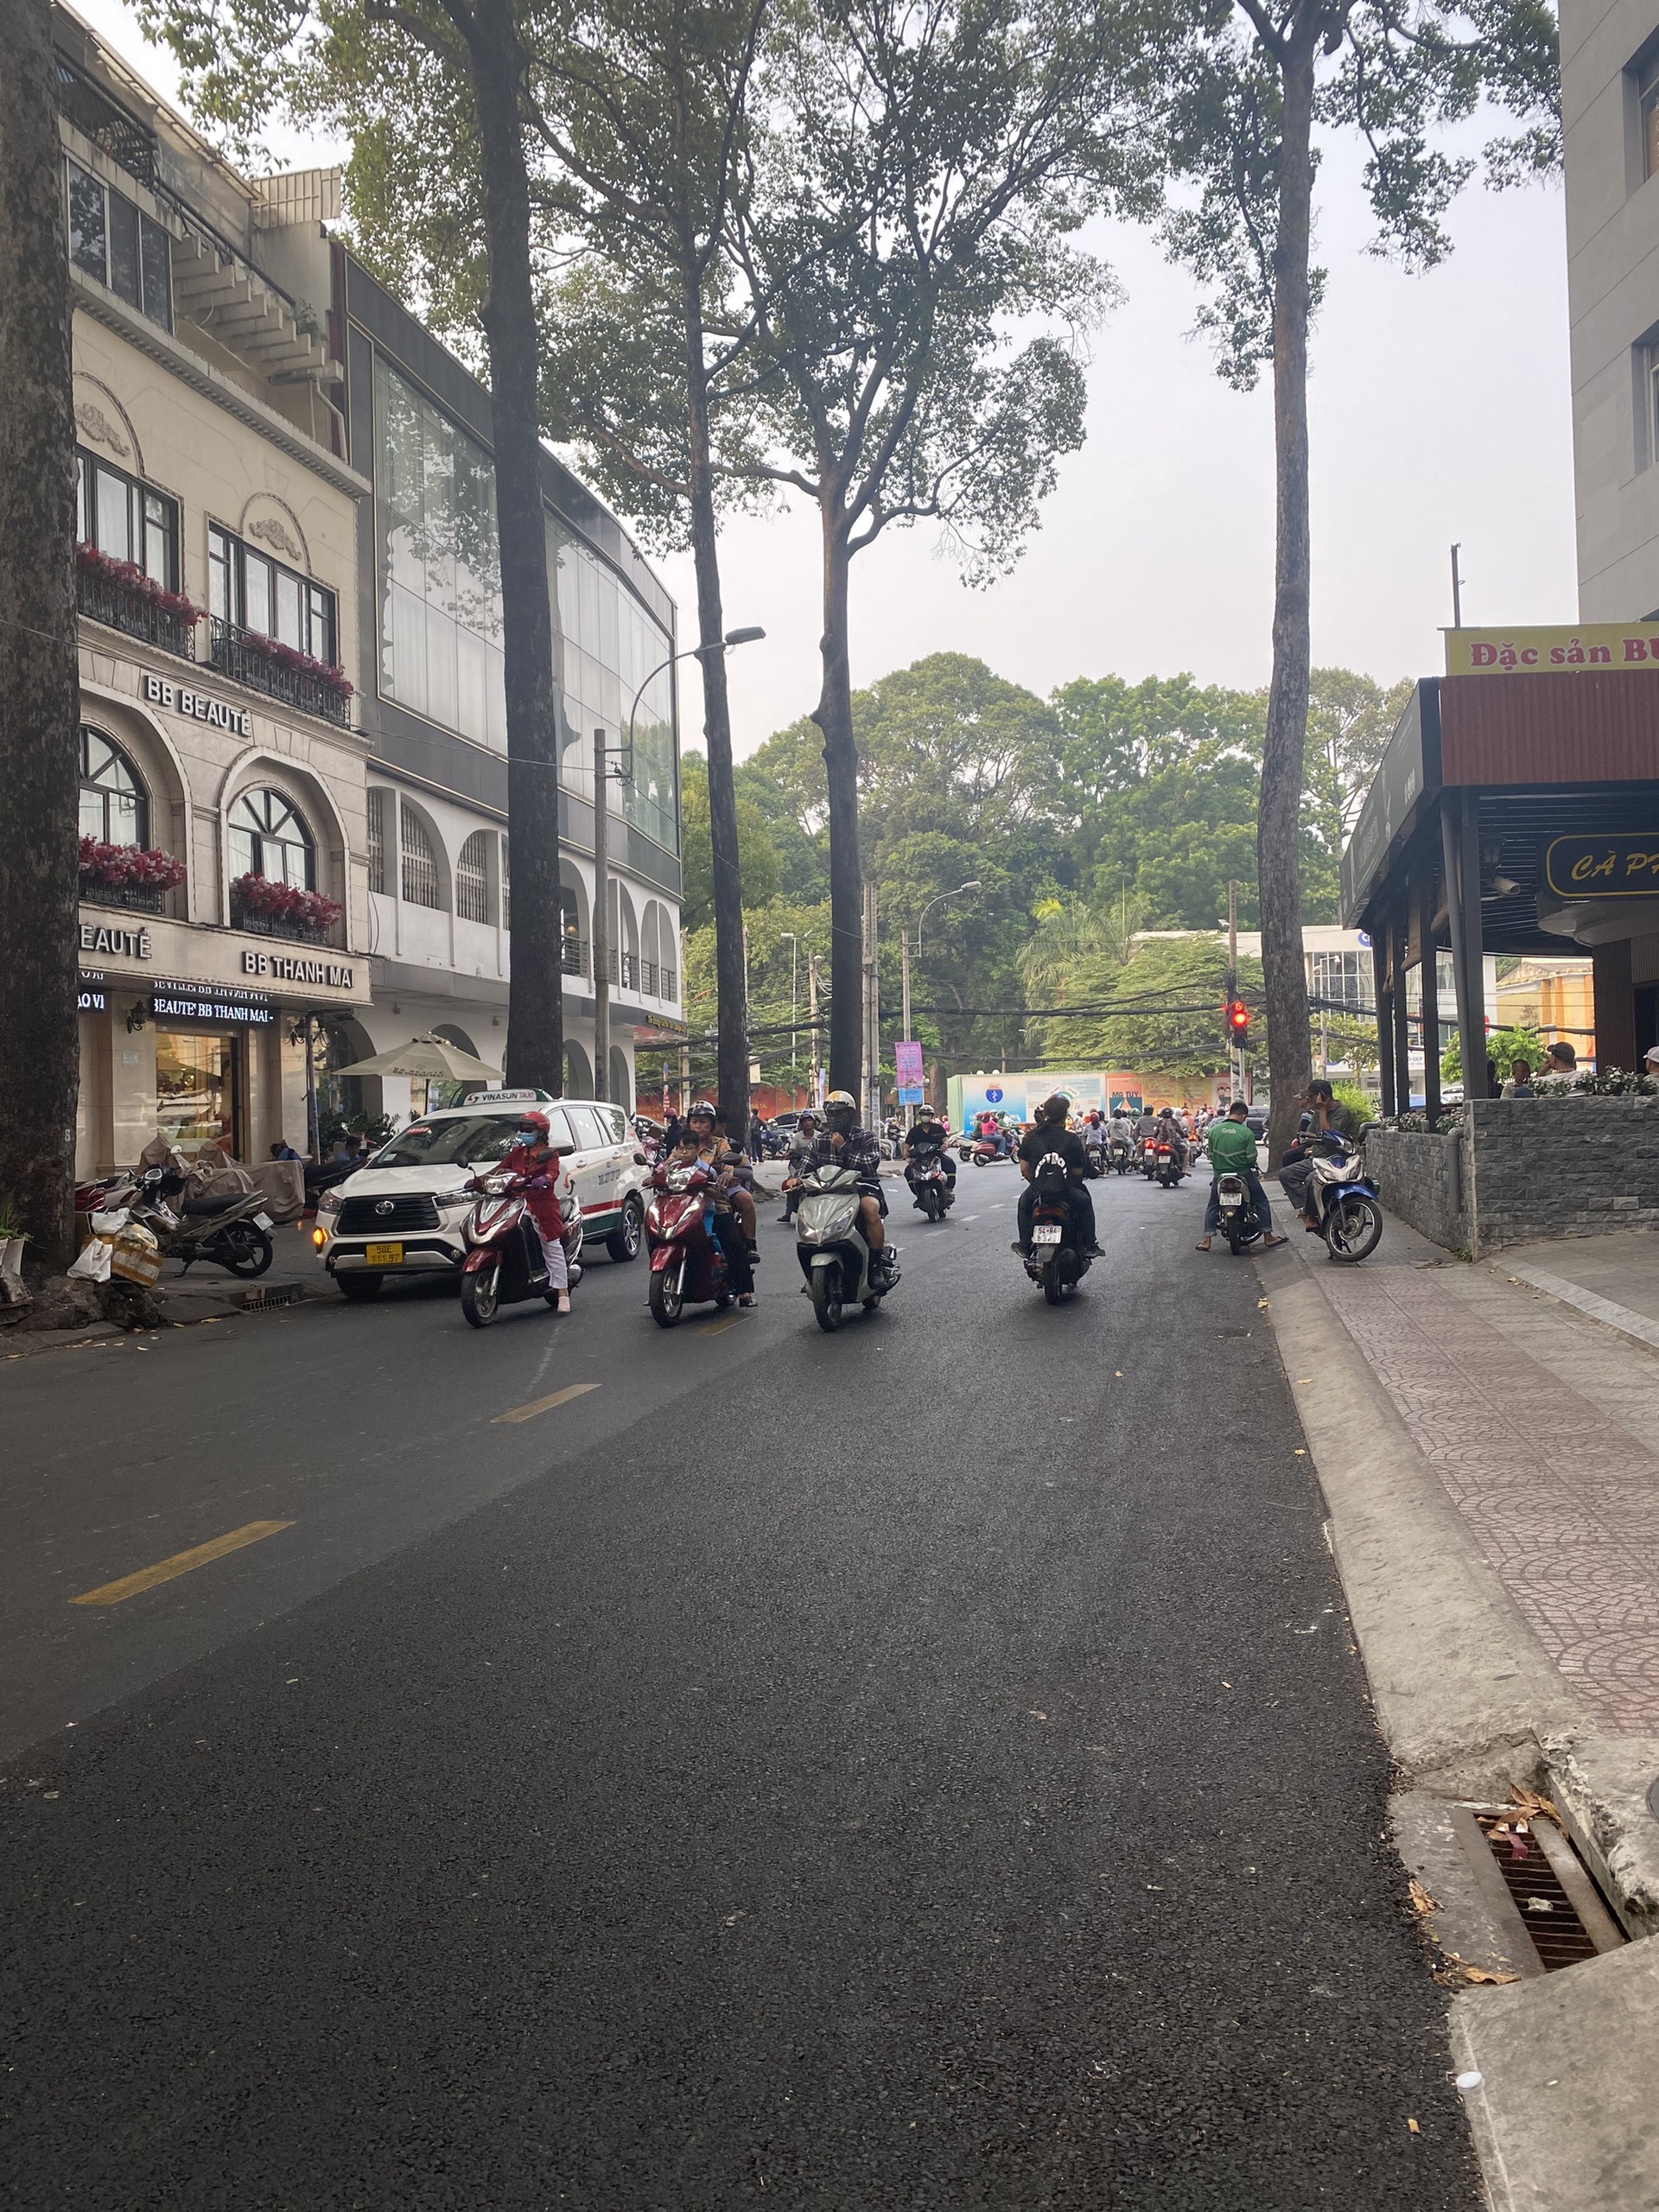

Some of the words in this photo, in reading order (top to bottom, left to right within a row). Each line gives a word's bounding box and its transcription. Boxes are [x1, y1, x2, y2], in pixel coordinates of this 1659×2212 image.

[1471, 642, 1538, 671] Đặc
[1550, 638, 1611, 664] sản
[146, 675, 174, 706] BB
[181, 689, 252, 737] BEAUTÉ
[1571, 850, 1617, 880] CÀ
[79, 925, 152, 959] EAUTÉ
[244, 951, 268, 974] BB
[272, 957, 325, 982] THANH
[329, 968, 354, 988] MAI
[197, 1002, 213, 1017] BB
[214, 1005, 249, 1020] THANH
[249, 1008, 269, 1023] MAI
[482, 1092, 518, 1101] VINASUN
